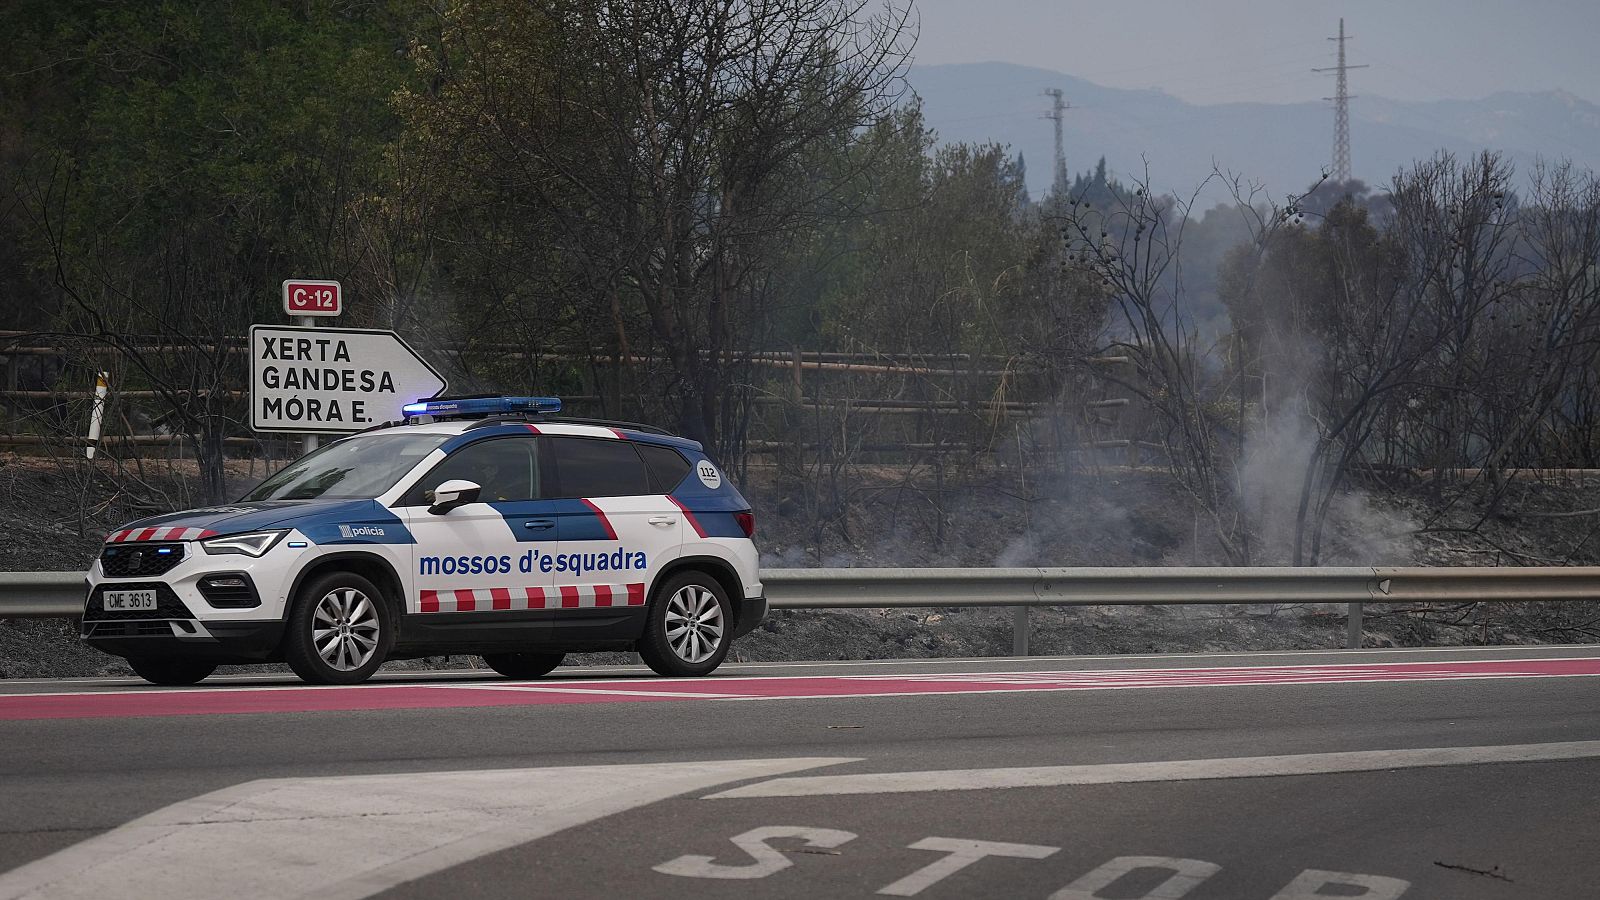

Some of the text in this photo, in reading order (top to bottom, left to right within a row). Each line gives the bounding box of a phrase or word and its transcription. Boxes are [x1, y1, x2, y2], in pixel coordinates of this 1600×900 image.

[293, 288, 333, 307] C-12
[261, 337, 351, 362] XERTA
[262, 366, 395, 393] GANDESA
[262, 395, 373, 422] MÓRA E.
[700, 467, 716, 477] 112
[352, 526, 384, 537] policia
[420, 547, 647, 576] mossos d'esquadra
[110, 593, 151, 608] CME 3613
